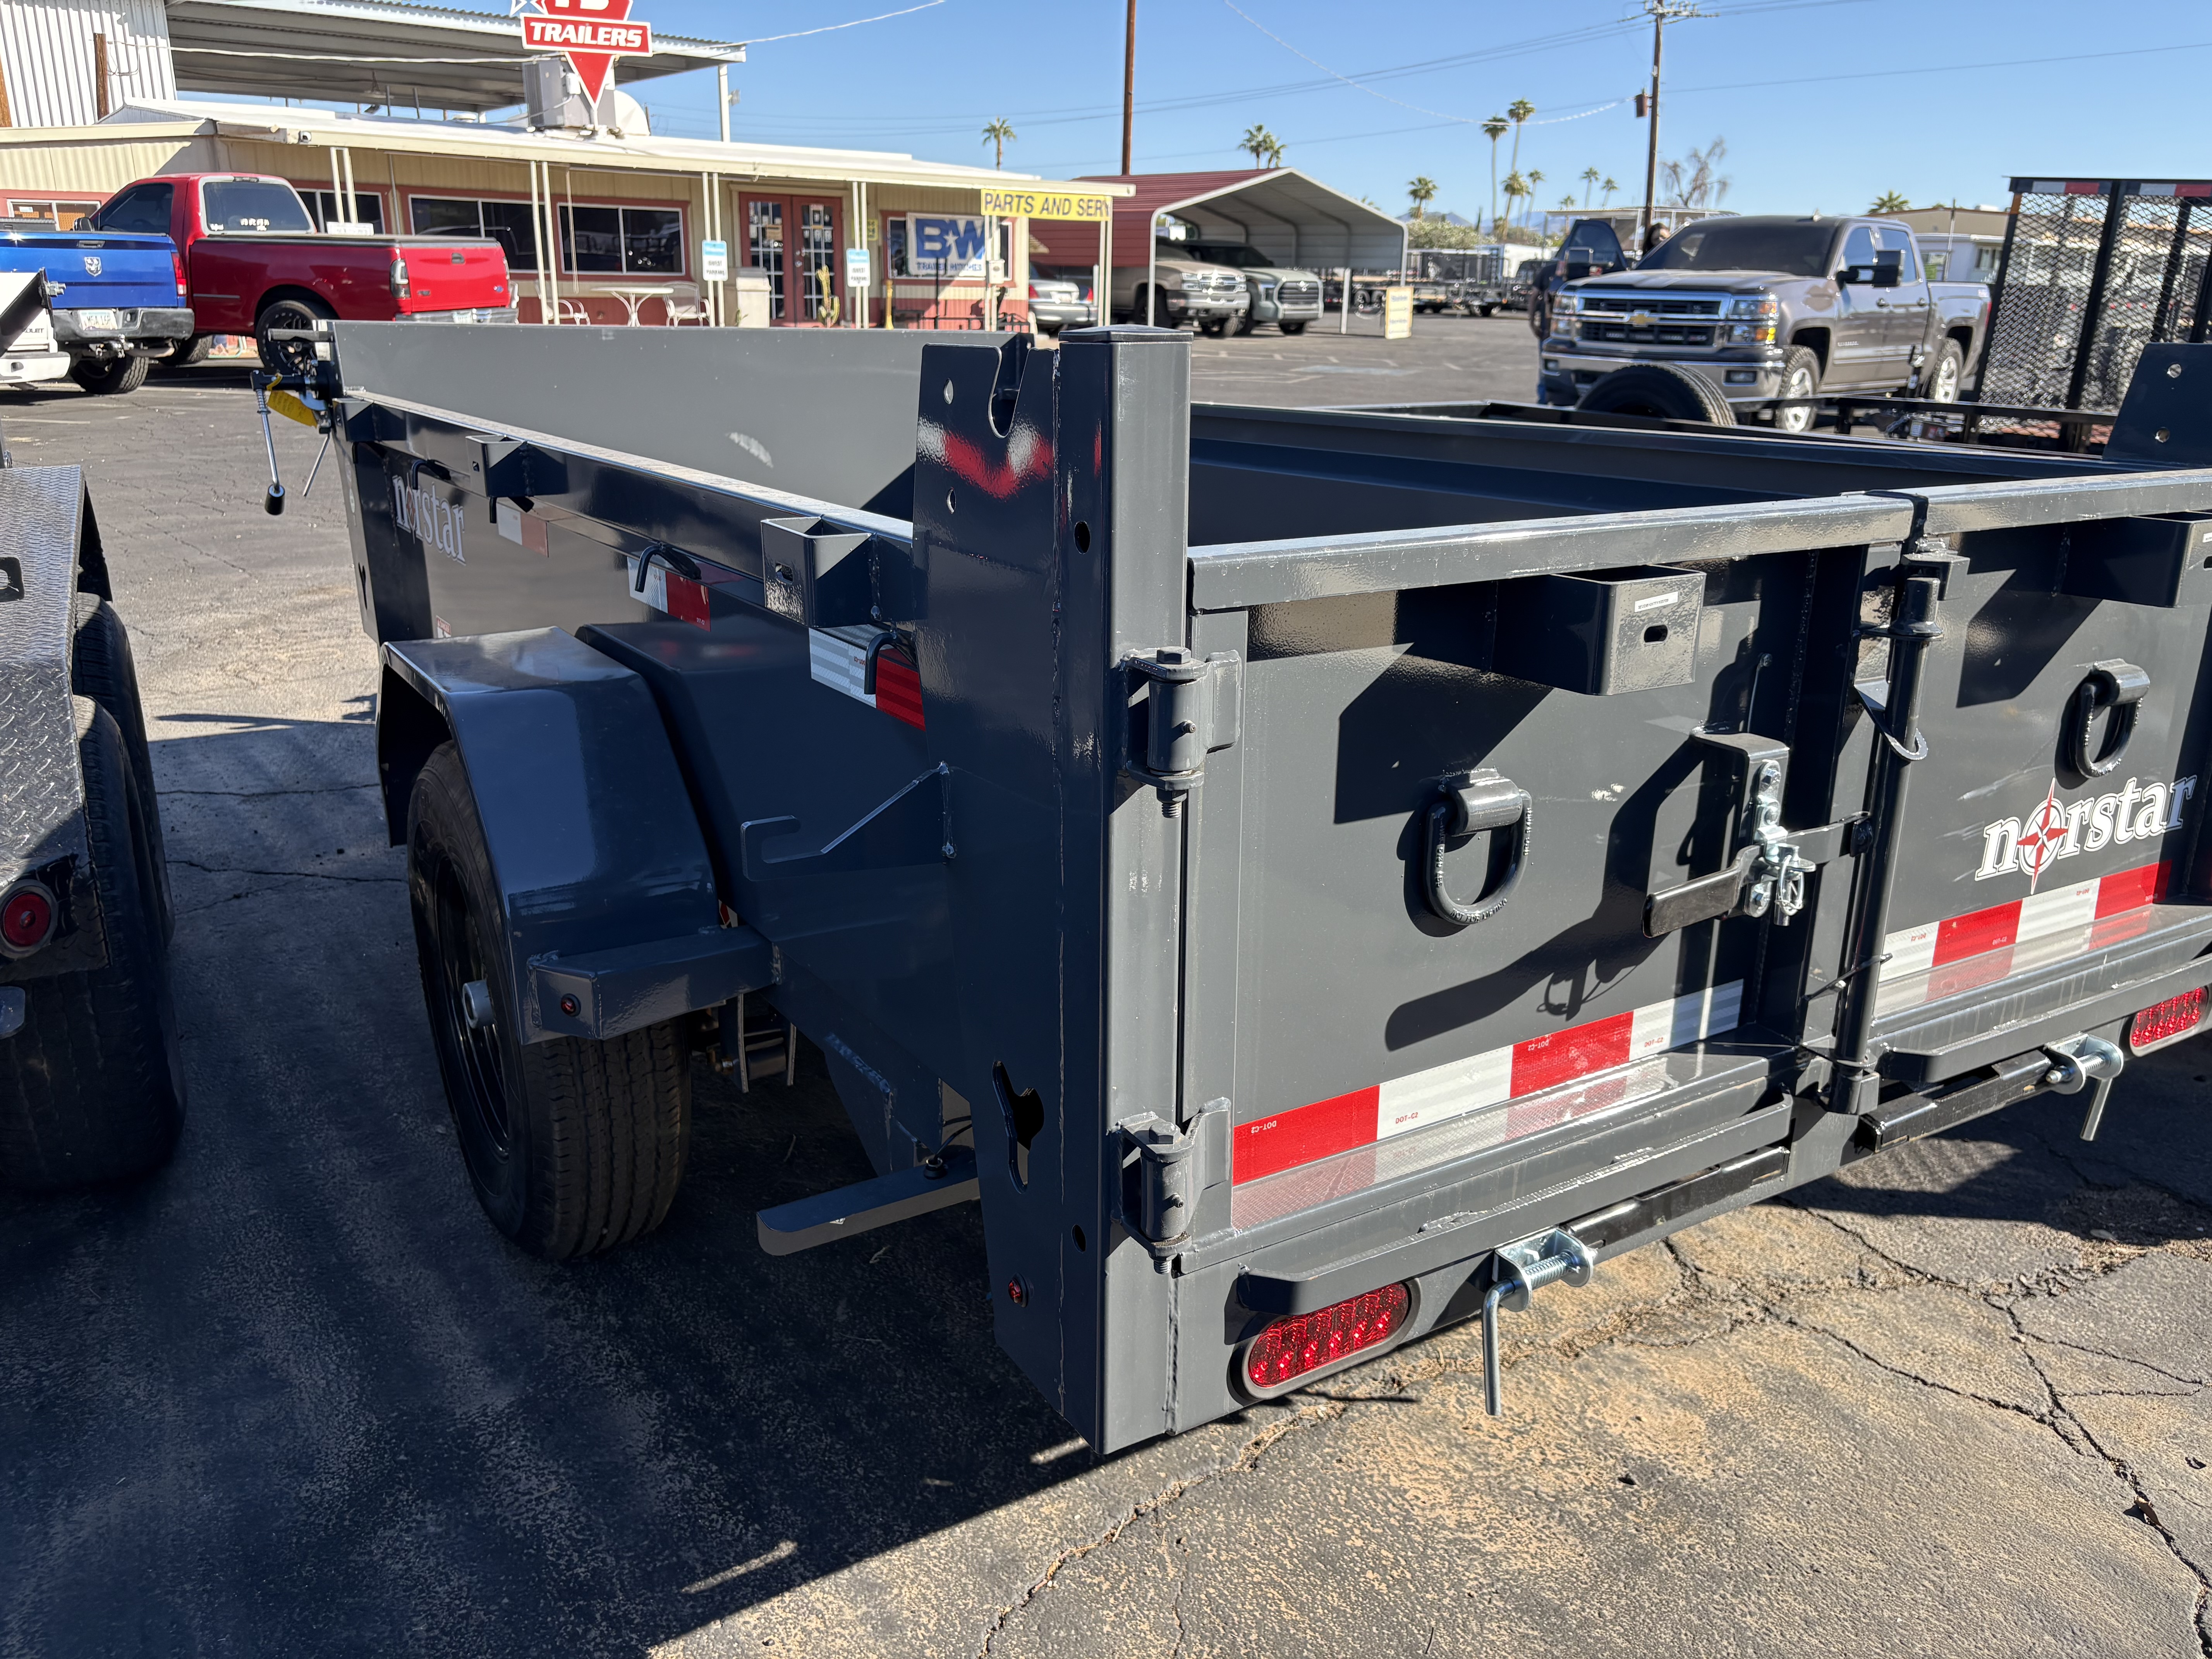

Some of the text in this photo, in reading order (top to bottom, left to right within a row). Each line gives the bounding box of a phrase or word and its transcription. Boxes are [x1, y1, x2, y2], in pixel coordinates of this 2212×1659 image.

[530, 22, 643, 47] TRAILERS
[985, 193, 1035, 213] PARTS
[1040, 197, 1072, 216] AND
[392, 474, 466, 566] norstar
[1975, 774, 2197, 887] norstar
[1528, 1039, 1549, 1051] DOT-C2
[1644, 1037, 1663, 1047] DOT-C2
[1251, 1120, 1277, 1133] DOT-C2
[1396, 1112, 1418, 1124] DOT-C2
